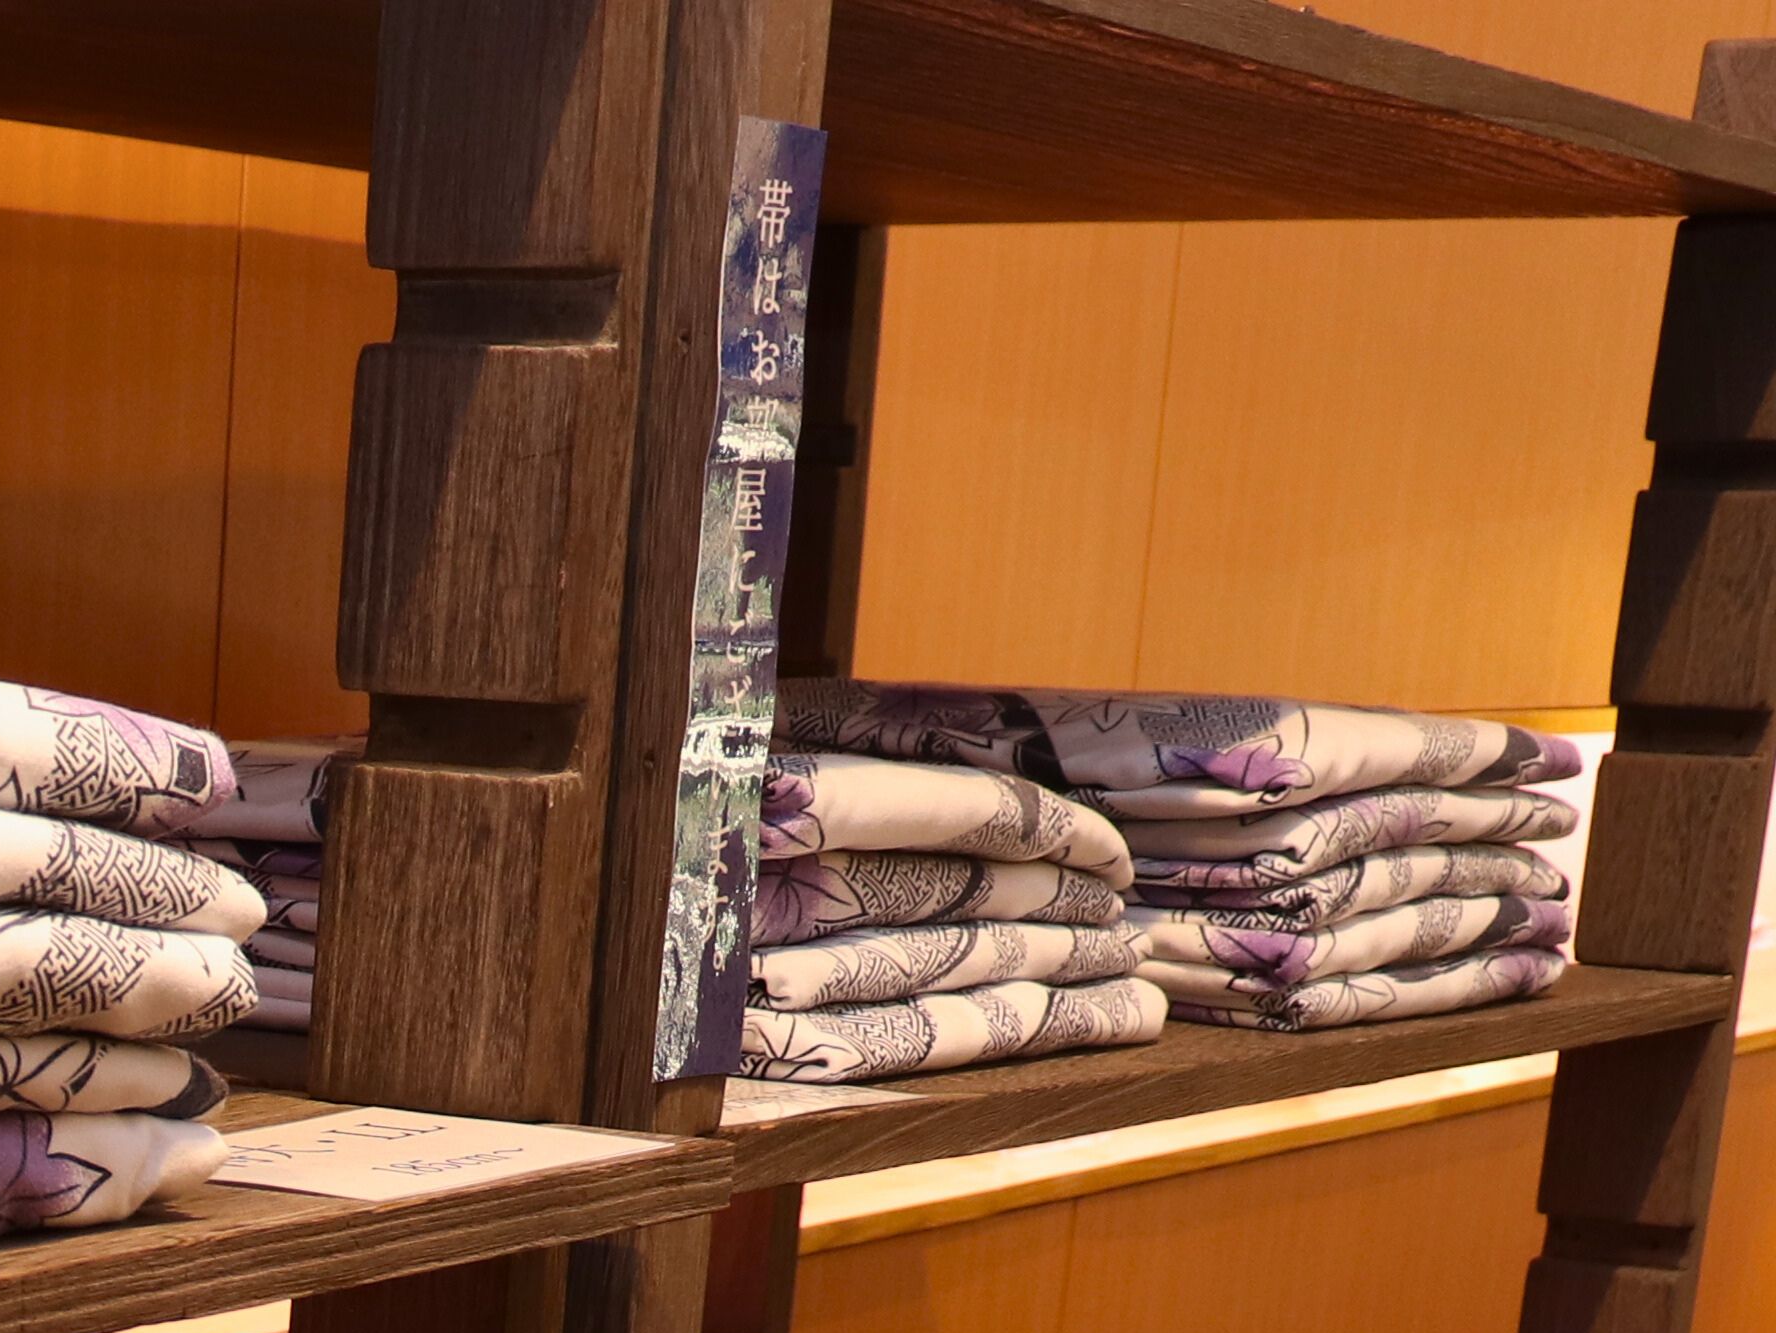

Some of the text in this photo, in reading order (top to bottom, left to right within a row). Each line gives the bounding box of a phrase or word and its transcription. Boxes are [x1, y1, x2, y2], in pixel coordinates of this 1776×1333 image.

[700, 179, 793, 972] 帯はお部屋にござます。
